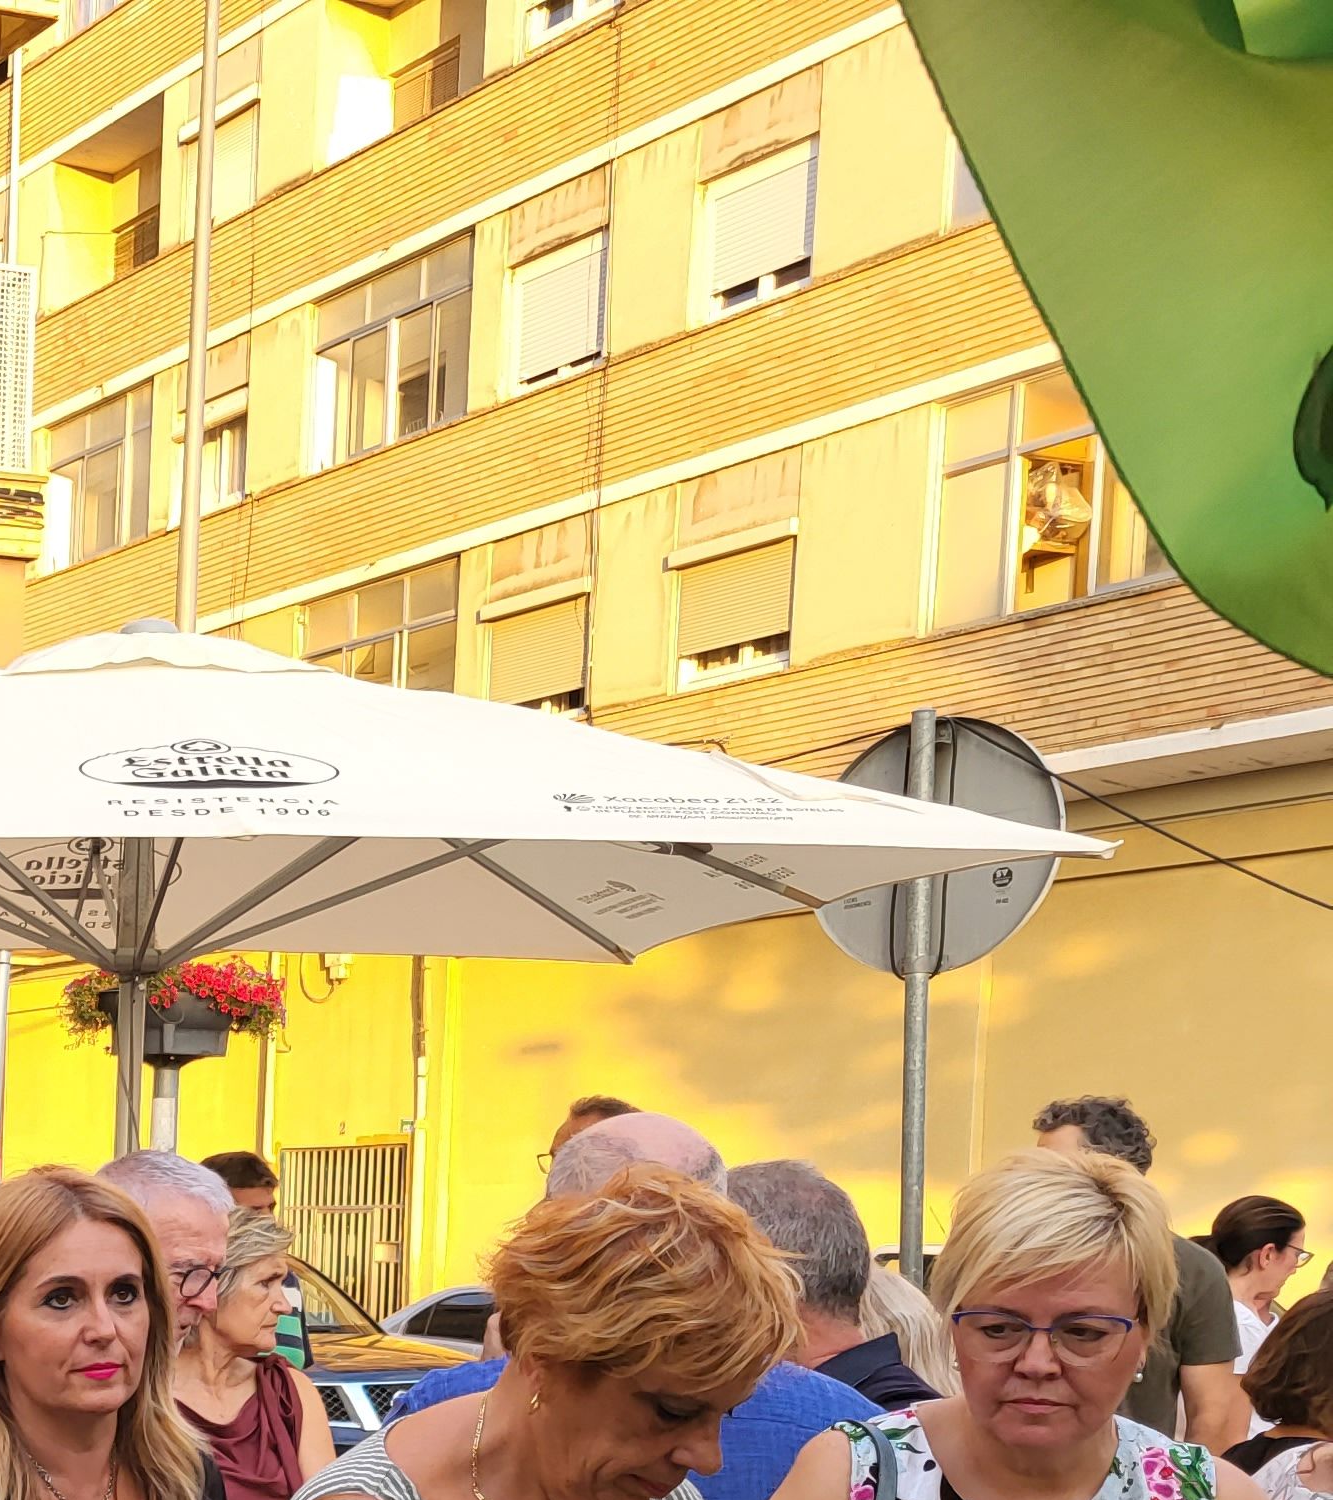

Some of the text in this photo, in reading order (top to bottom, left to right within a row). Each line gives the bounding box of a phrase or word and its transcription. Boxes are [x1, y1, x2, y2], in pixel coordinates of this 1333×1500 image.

[123, 755, 294, 768] Estrella
[131, 765, 294, 779] Galicia
[107, 796, 340, 806] RESISTENCIA
[603, 796, 719, 805] Xacobeo
[123, 806, 332, 818] DESDE 1906
